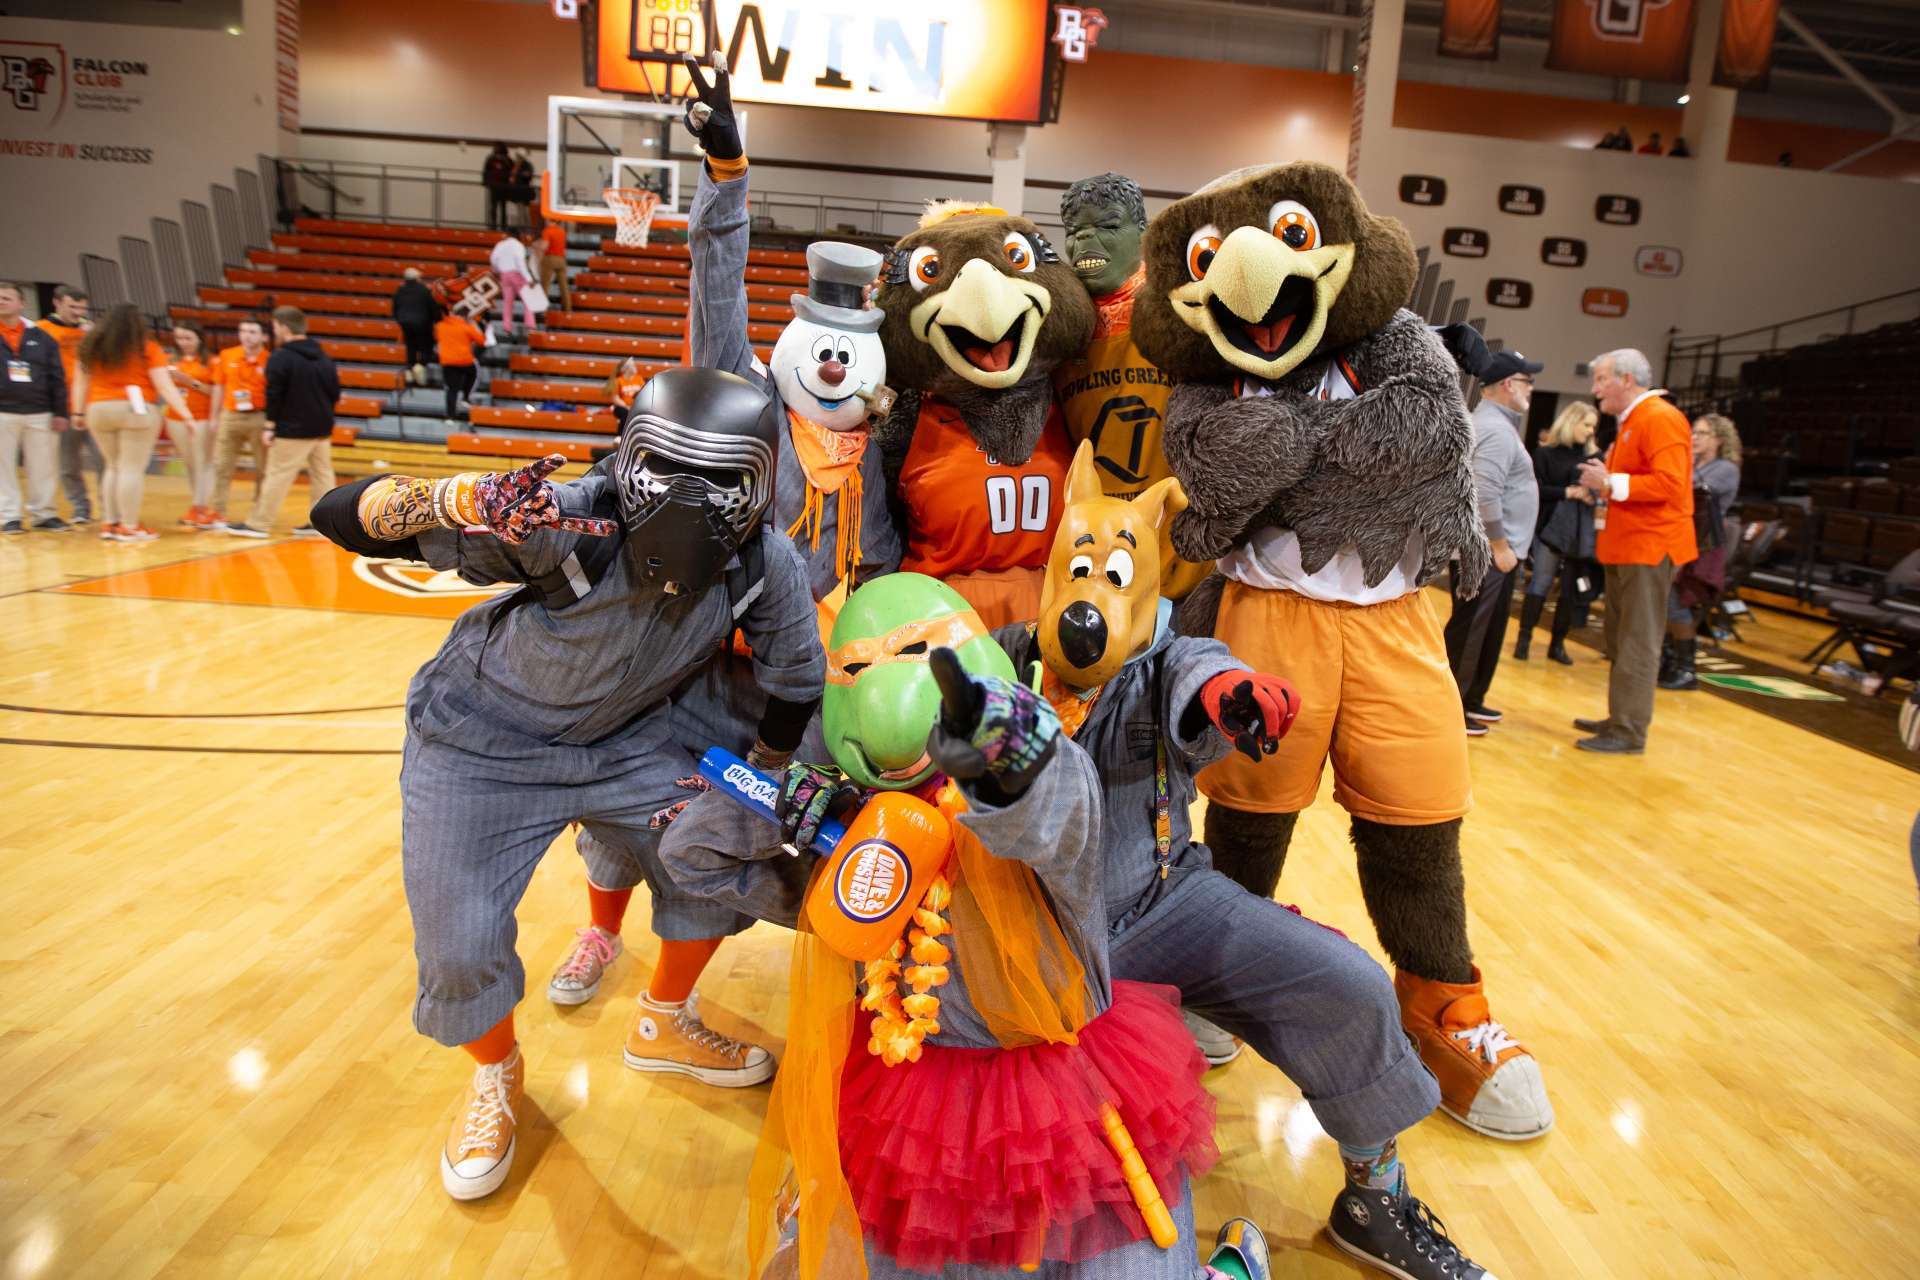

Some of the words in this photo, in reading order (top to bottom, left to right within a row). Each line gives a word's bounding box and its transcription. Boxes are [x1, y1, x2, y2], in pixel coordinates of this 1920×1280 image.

[708, 3, 948, 99] WIN
[73, 58, 148, 75] FALCON
[74, 73, 123, 88] CLUB
[58, 143, 75, 159] IN
[79, 144, 154, 164] SUCCESS
[1124, 367, 1178, 388] GREEN
[984, 475, 1051, 535] 00
[727, 767, 754, 788] BIG
[868, 853, 897, 900] DAVE
[864, 898, 886, 912] &
